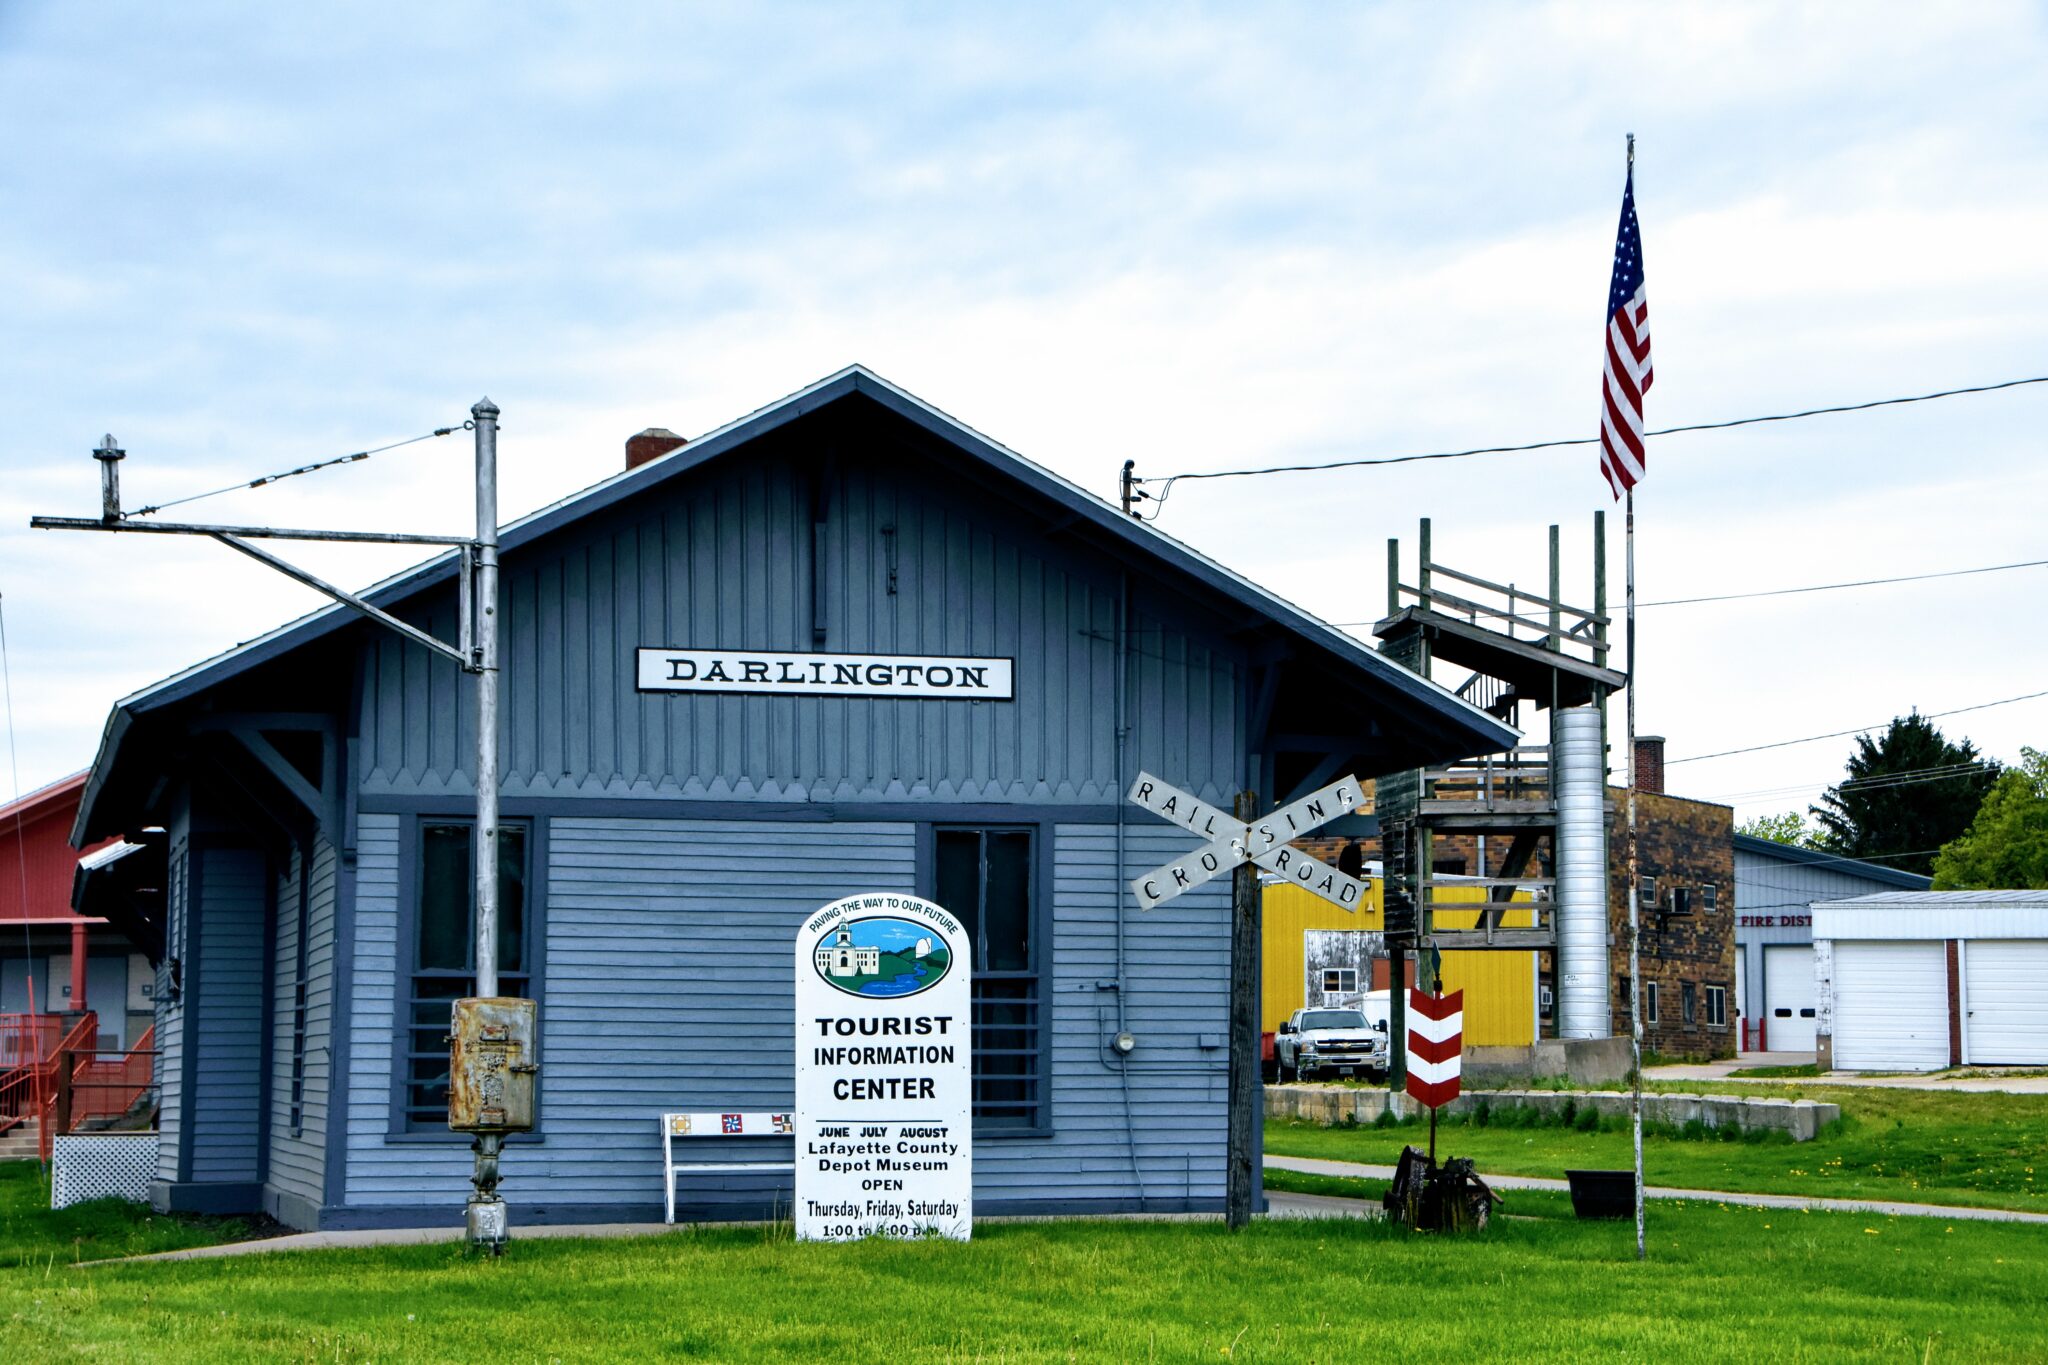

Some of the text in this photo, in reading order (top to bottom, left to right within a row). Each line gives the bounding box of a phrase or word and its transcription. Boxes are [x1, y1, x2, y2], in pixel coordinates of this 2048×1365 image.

[666, 659, 989, 688] DARLINGTON
[1137, 782, 1216, 835] RAIL
[1275, 850, 1358, 903] ROAD
[809, 898, 959, 935] PAVING THE WAY TO OUR FUTURE
[1741, 916, 1774, 927] FIRE
[815, 1016, 953, 1037] TOURIST
[814, 1046, 954, 1066] INFORMATION
[833, 1078, 936, 1101] CENTER
[818, 1127, 949, 1138] JUNE JULY AUGUST
[808, 1141, 958, 1157] Lafayette County
[819, 1159, 949, 1174] Depot Museum
[861, 1180, 903, 1191] OPEN
[807, 1199, 959, 1219] Thursday, Friday, Saturday
[823, 1225, 853, 1237] 1:00
[858, 1225, 872, 1236] to
